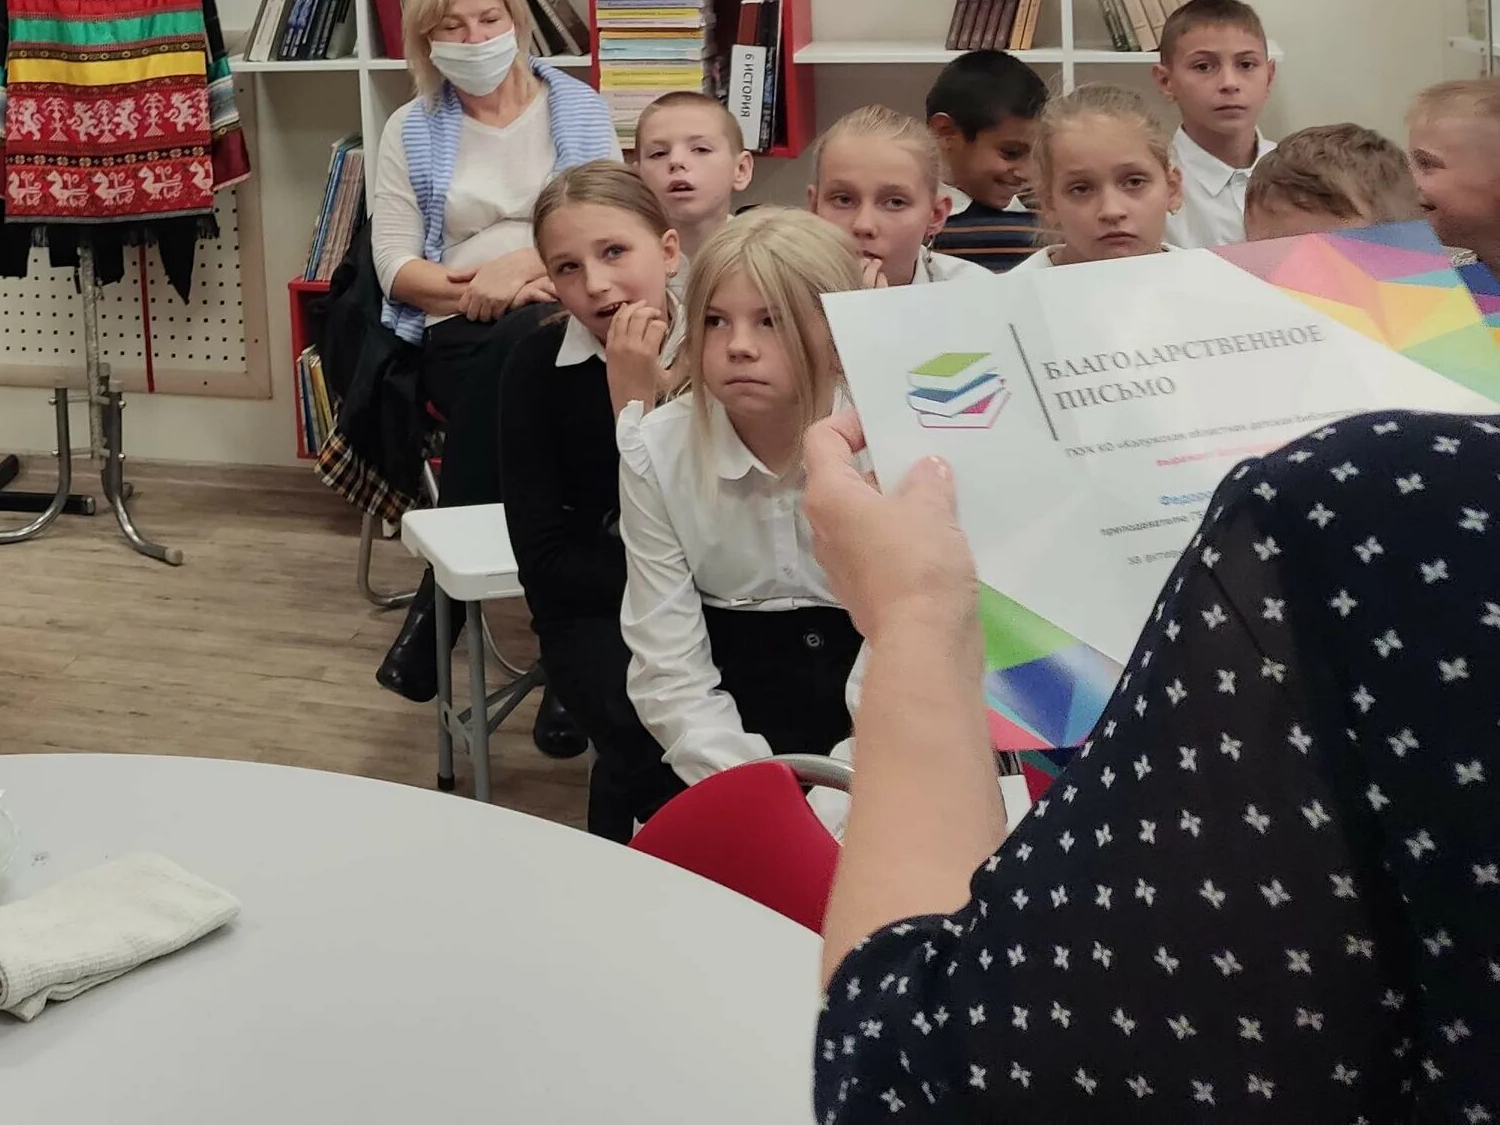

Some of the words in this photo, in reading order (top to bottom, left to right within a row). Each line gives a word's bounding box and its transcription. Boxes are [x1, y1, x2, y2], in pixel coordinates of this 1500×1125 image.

[744, 52, 756, 62] 6
[740, 66, 756, 119] ИСТОРИЯ
[1041, 323, 1327, 381] БЛАГОДАРСТВЕННОЕ
[1054, 376, 1177, 411] ПИСЬМО
